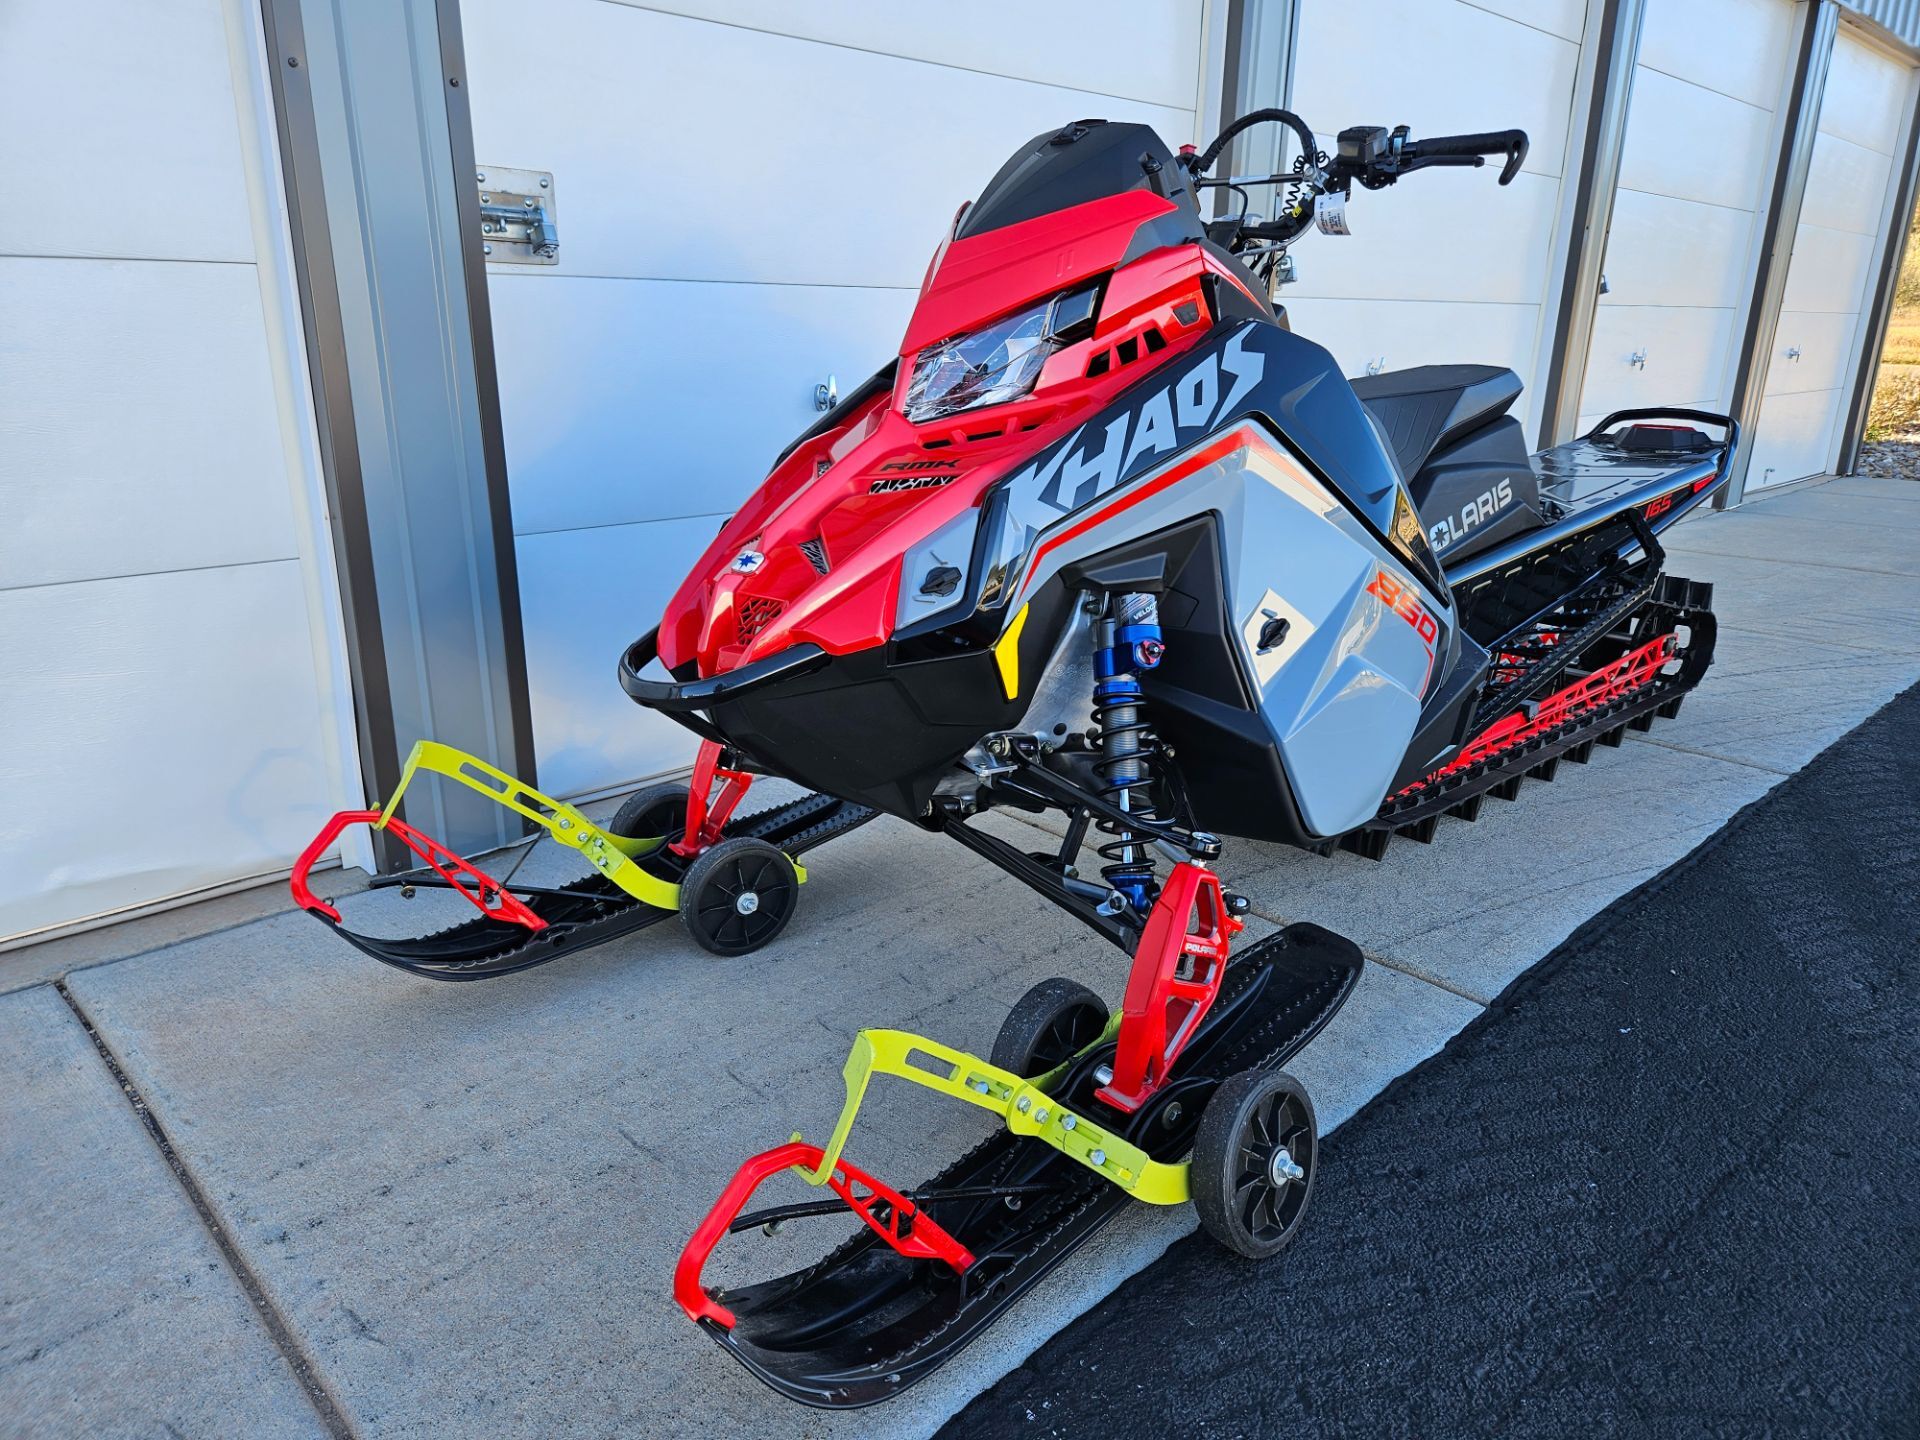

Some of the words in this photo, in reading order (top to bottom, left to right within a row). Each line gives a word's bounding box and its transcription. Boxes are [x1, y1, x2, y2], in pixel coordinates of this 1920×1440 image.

[880, 459, 960, 471] RMK
[999, 322, 1265, 570] KHAOS
[1430, 477, 1512, 552] OLARIS
[1645, 493, 1673, 520] 165
[1366, 571, 1437, 645] 850
